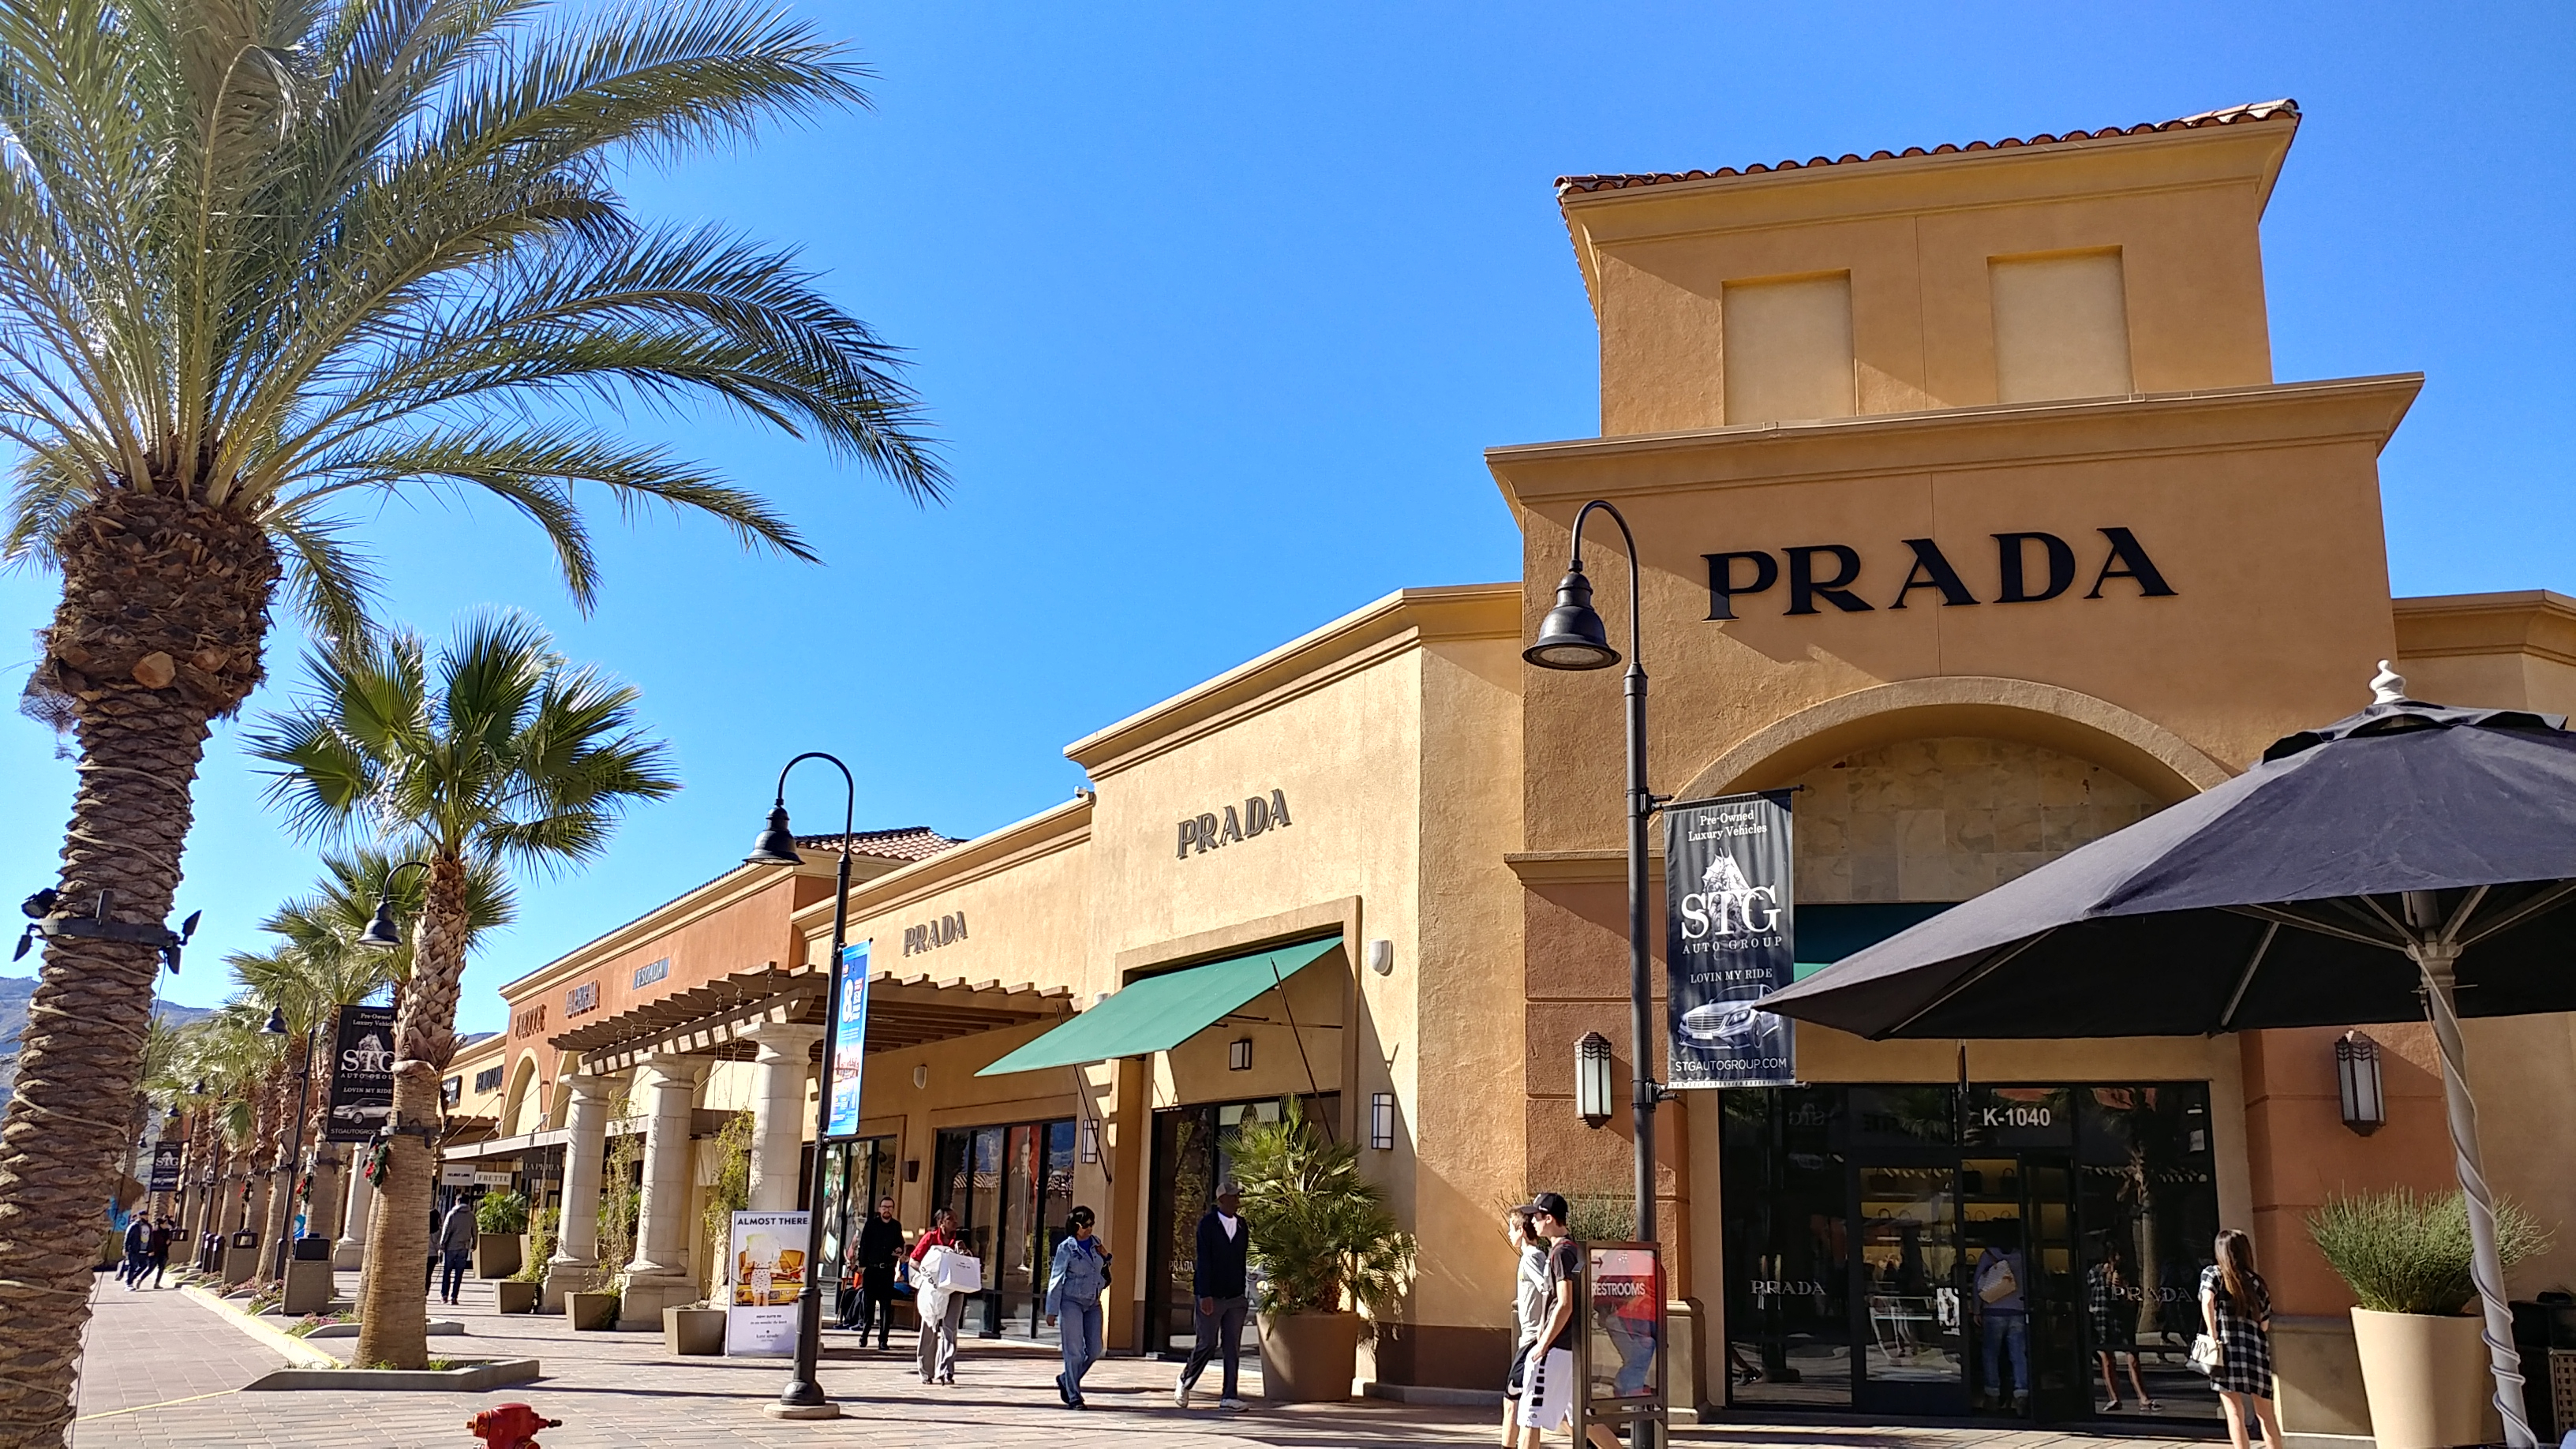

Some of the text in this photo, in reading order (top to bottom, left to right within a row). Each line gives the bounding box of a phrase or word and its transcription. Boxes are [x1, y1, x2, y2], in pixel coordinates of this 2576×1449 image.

[1700, 526, 2180, 623] PRADA
[1176, 788, 1293, 860] PRADA
[1699, 810, 1754, 826] Pre-Owned
[1687, 823, 1768, 842] Luxury Vehicles
[1681, 885, 1782, 940] STG
[902, 911, 968, 957] PRADA
[1682, 936, 1783, 955] AUTO GROUP
[636, 962, 663, 987] ESCADA
[1690, 968, 1773, 984] LOVIN MY RIDE
[341, 1049, 395, 1073] STG
[1675, 1058, 1788, 1073] STGAUTOGROUP.COM
[1983, 1107, 2051, 1127] K-1040
[155, 1157, 179, 1166] STG
[1169, 1260, 1195, 1272] PRADA
[1591, 1282, 1646, 1296] RESTROOMS
[1750, 1279, 1827, 1295] PRADA
[2110, 1286, 2194, 1302] PRADA
